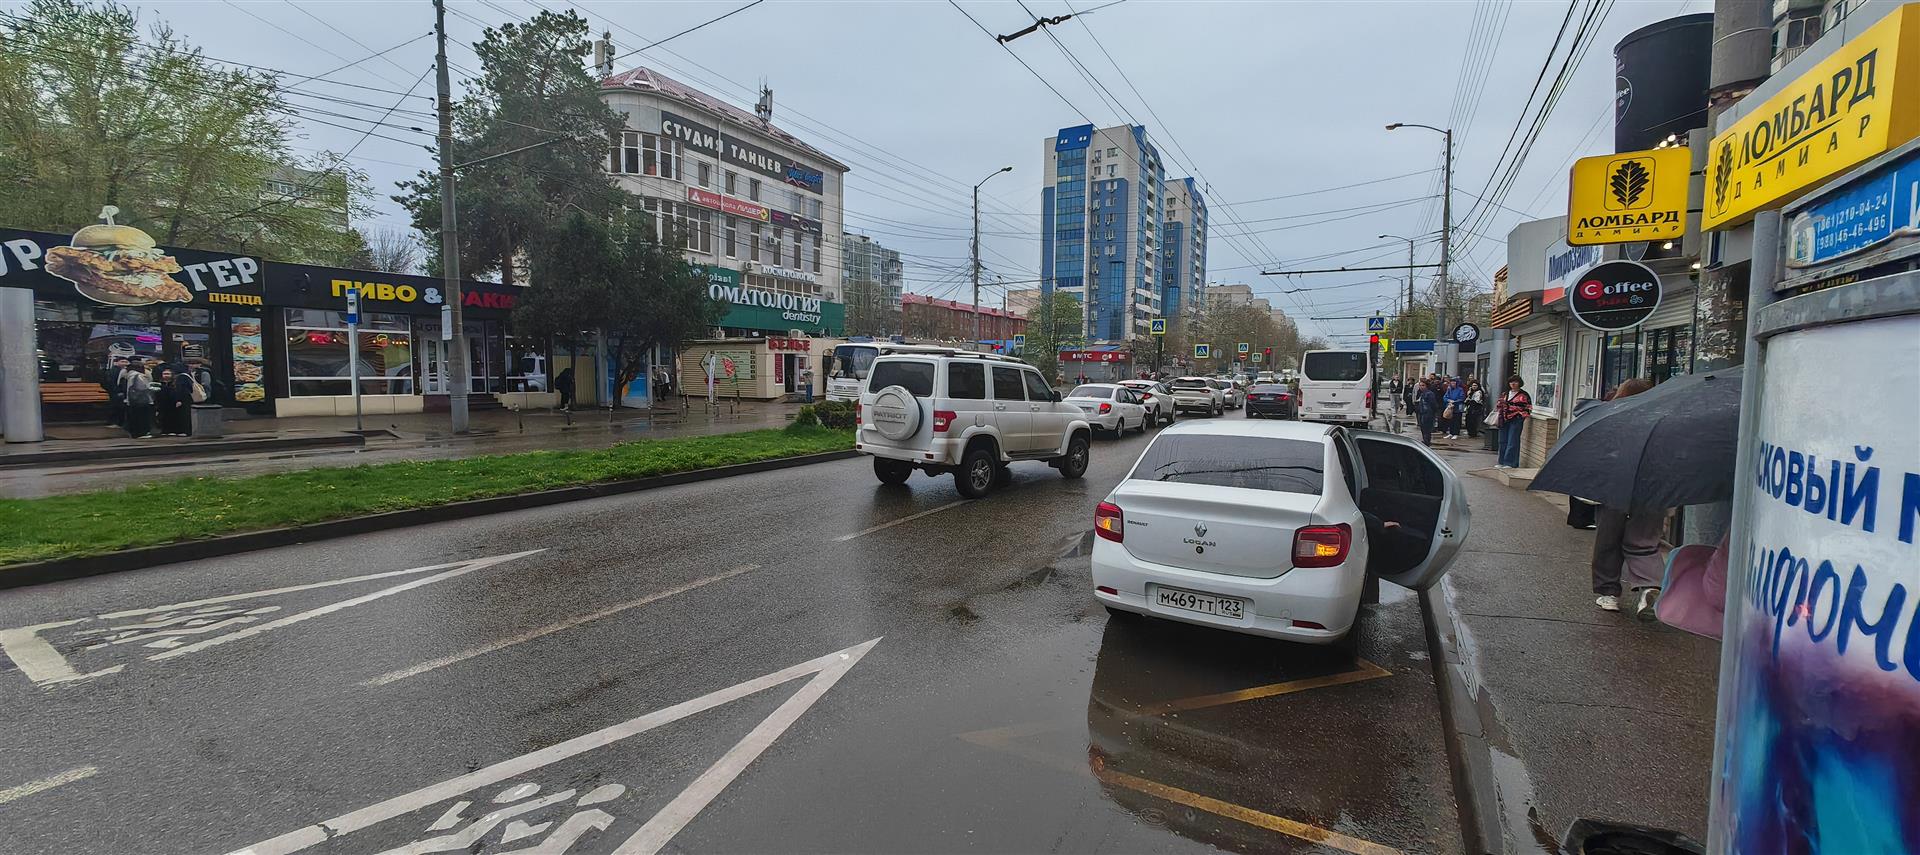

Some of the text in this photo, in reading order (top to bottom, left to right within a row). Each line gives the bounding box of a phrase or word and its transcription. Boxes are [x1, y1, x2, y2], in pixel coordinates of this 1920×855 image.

[1737, 48, 1878, 170] ЛОМБАРД
[662, 119, 782, 174] СТУДИЯ ТАНЦЕВ
[1734, 115, 1871, 200] ДАМИАР
[1577, 211, 1680, 229] ЛОМБАРД
[1576, 225, 1680, 238] ДАМИАР
[183, 257, 258, 292] ГЕР
[332, 279, 513, 309] ПИВО & АКИ
[1584, 281, 1653, 297] Coffee
[209, 293, 263, 305] ПИЦЦА
[782, 310, 821, 325] dentistry
[873, 411, 908, 419] PATRIOT
[1127, 519, 1148, 527] RENAULT
[1183, 538, 1216, 547] LOGAN
[1161, 592, 1241, 612] М469ТТ 123
